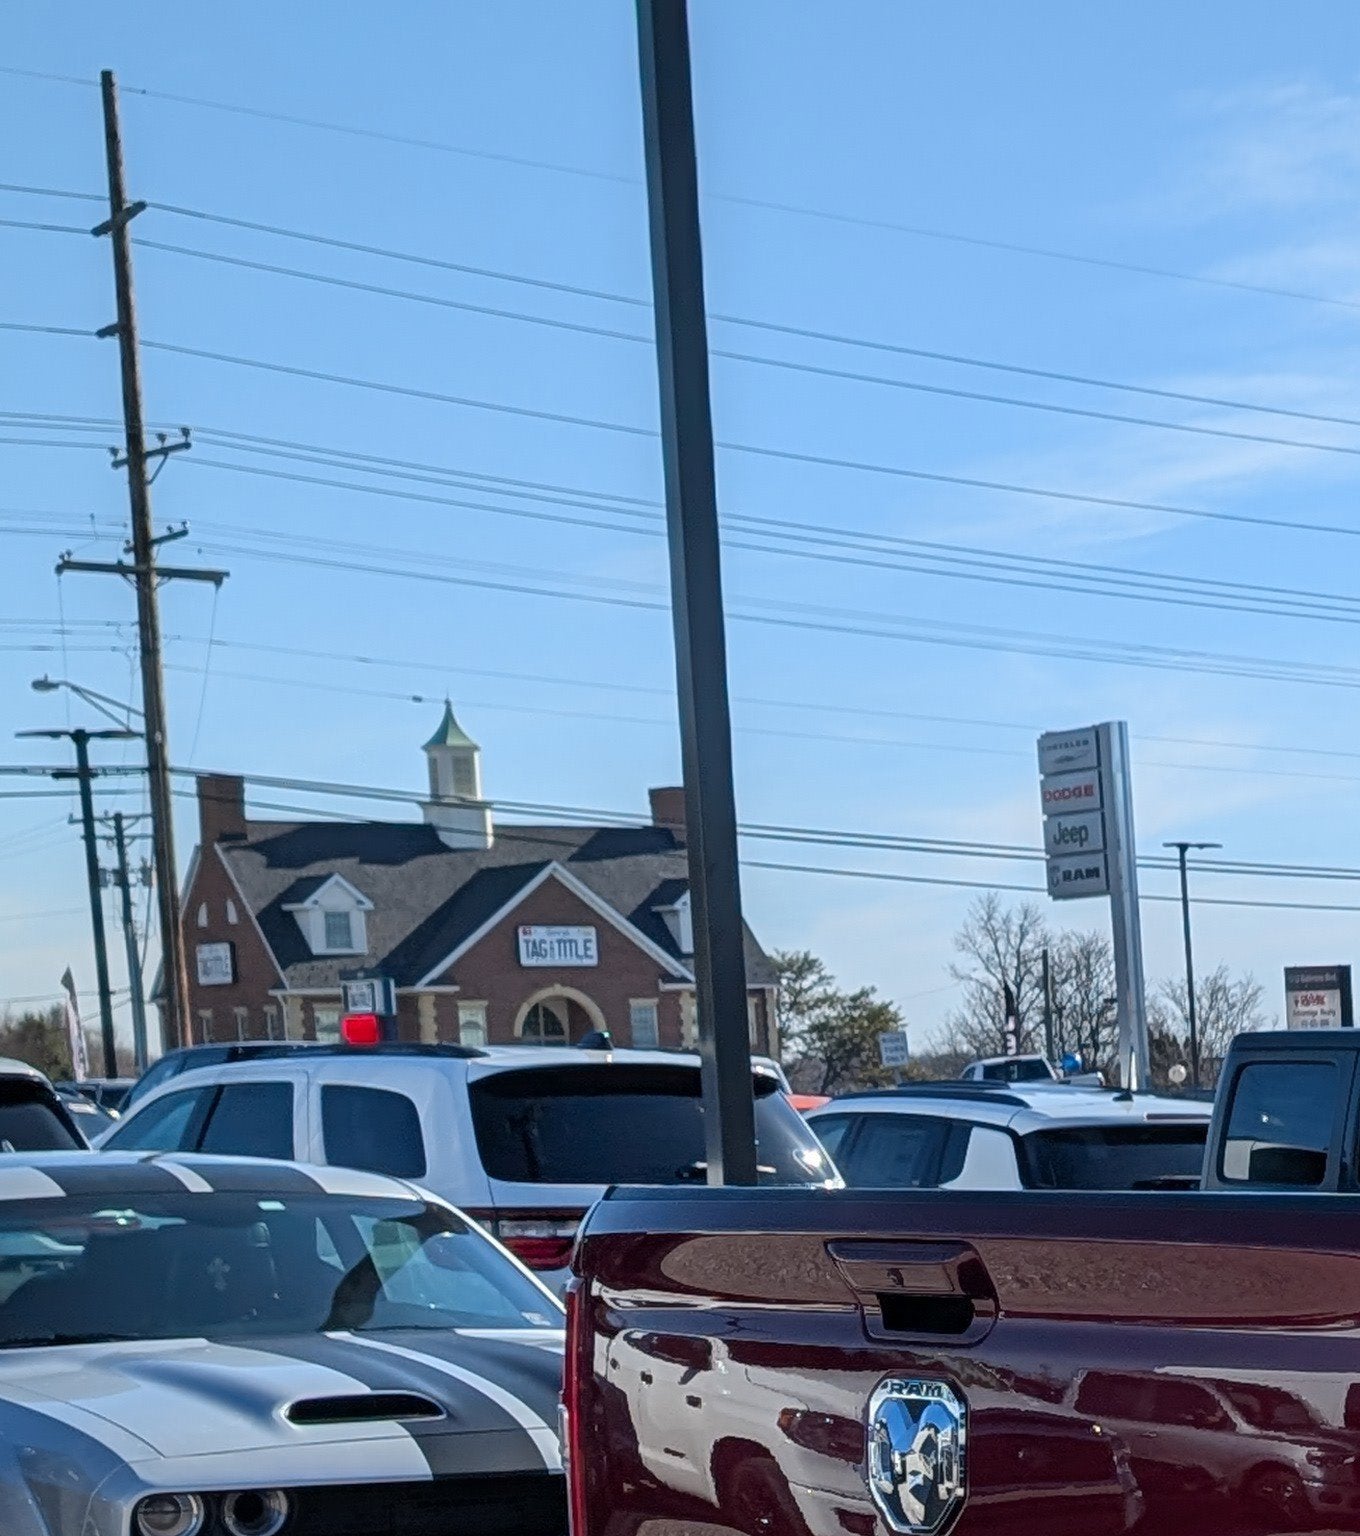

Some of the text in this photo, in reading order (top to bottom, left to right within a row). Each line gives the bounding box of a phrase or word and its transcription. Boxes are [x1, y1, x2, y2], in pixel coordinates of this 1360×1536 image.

[1043, 785, 1094, 801] DODGE
[1053, 820, 1089, 848] Jeep
[1062, 866, 1100, 882] RAM
[523, 939, 548, 959] TAG
[556, 938, 594, 959] TITLE
[887, 1381, 943, 1397] RAM
